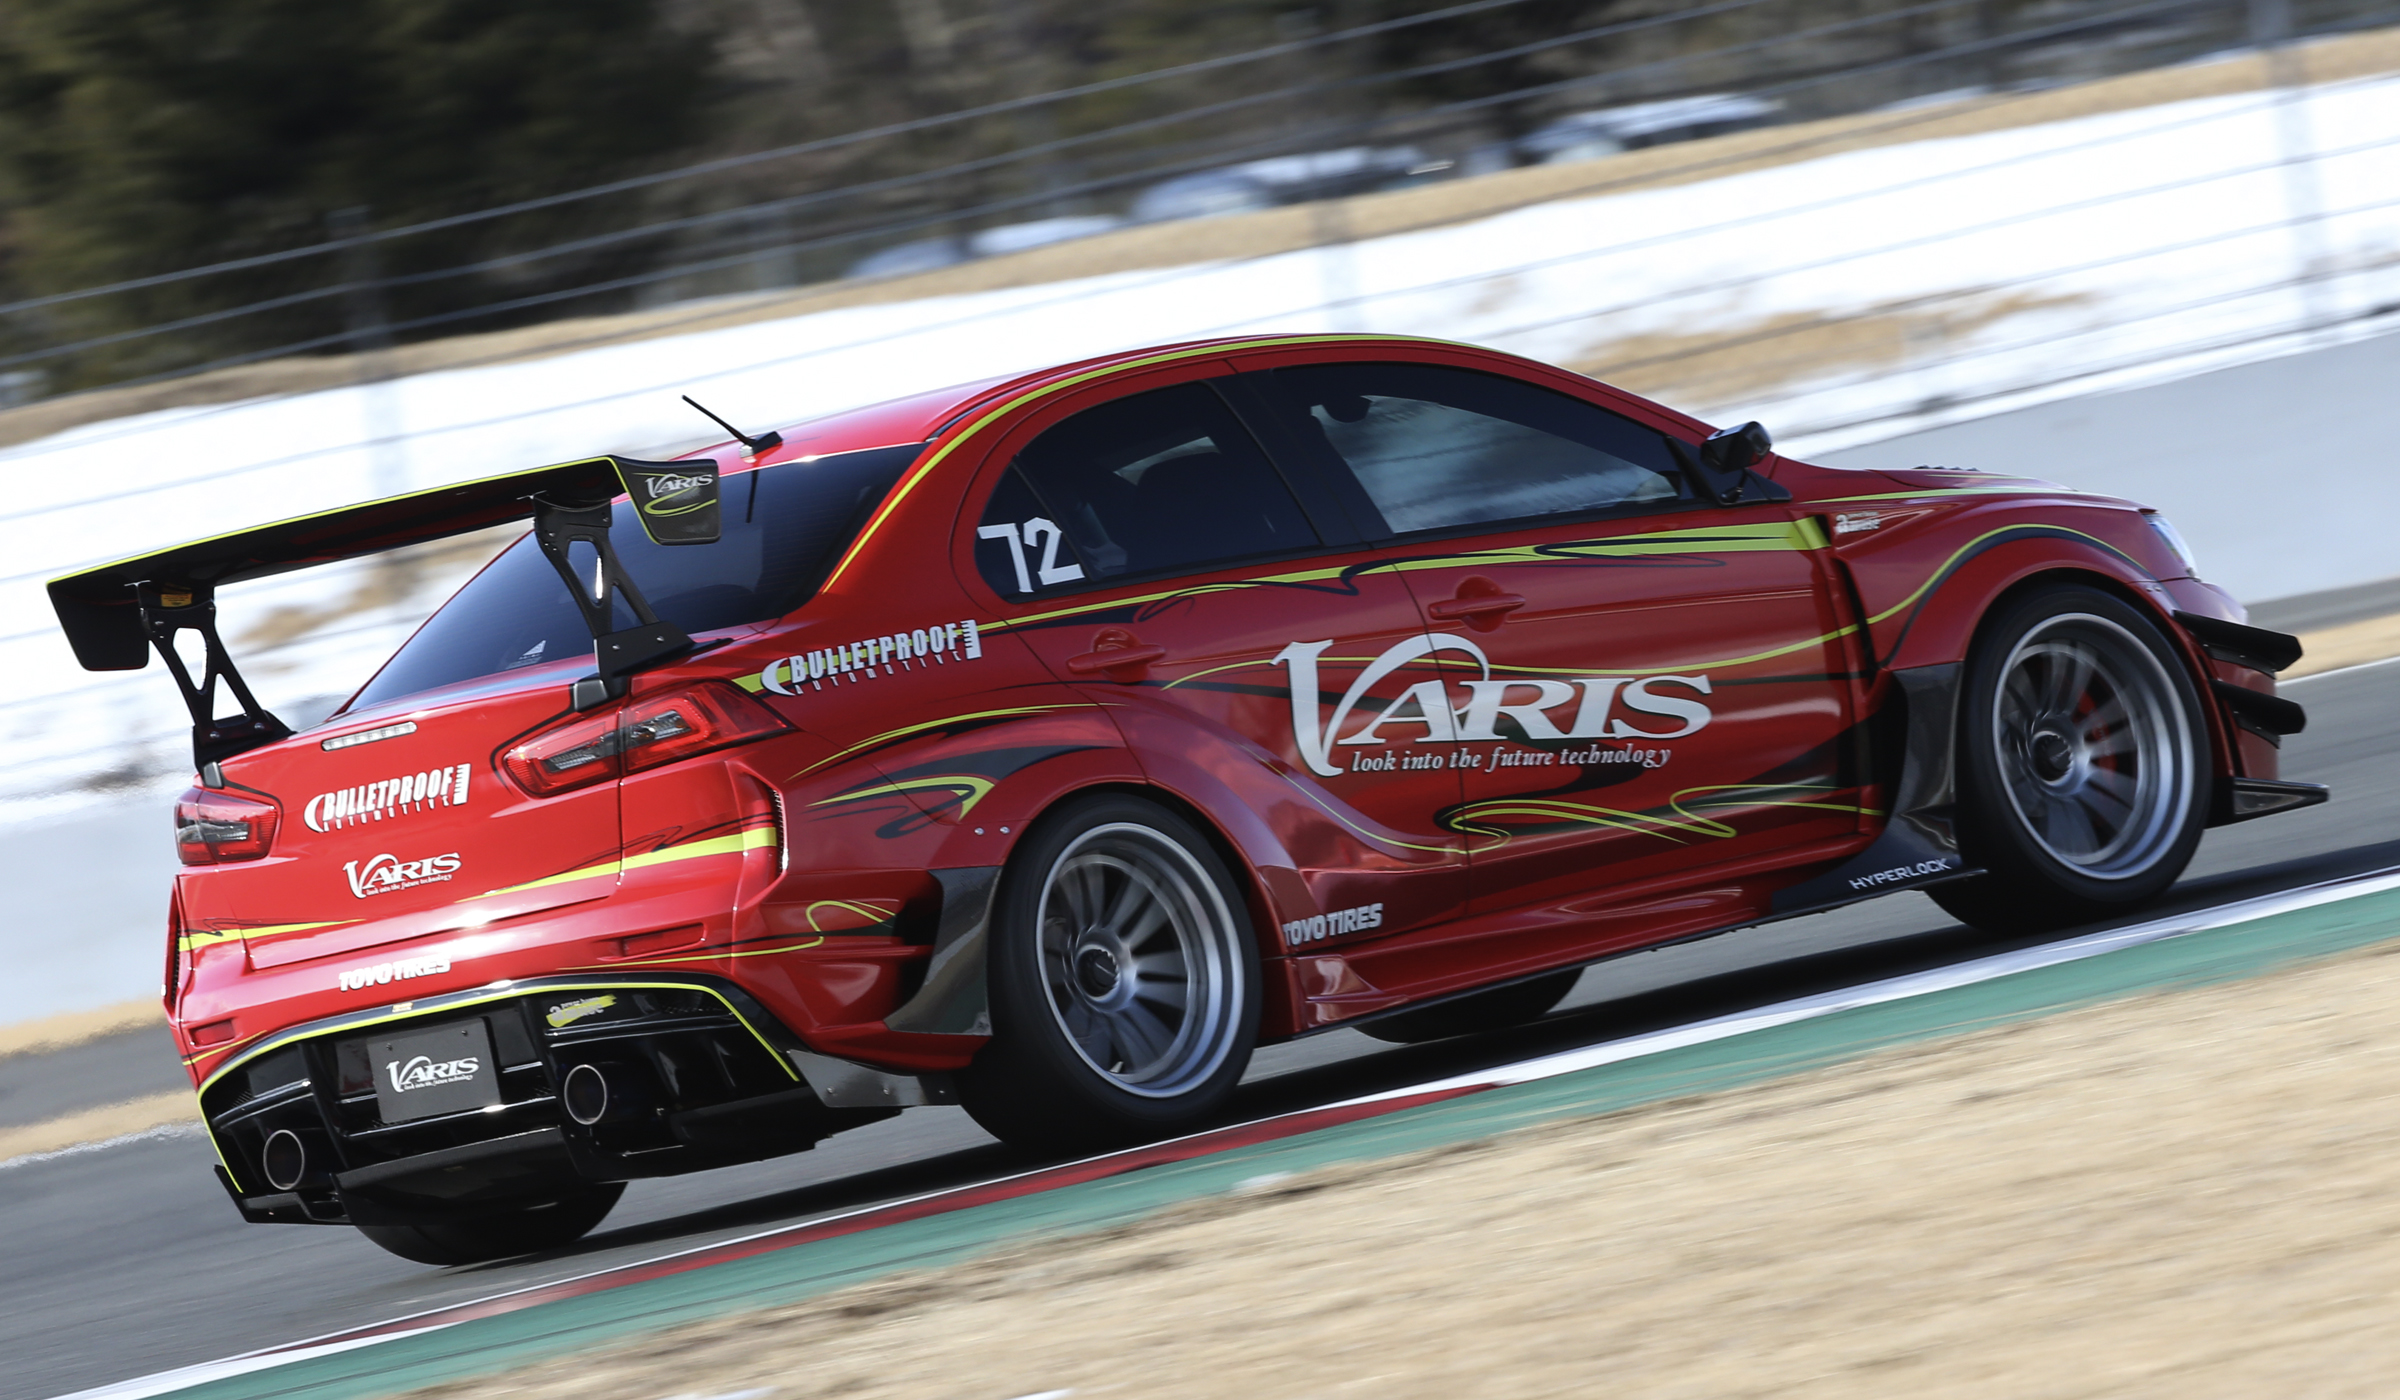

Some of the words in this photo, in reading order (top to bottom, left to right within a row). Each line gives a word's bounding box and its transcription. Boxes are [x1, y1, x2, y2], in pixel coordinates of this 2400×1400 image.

[645, 473, 713, 498] VARIS
[977, 517, 1085, 593] 72
[788, 622, 958, 684] BULLETPROOF
[1269, 633, 1713, 777] VARIS
[1352, 750, 1397, 772] look
[1402, 750, 1444, 770] into
[1449, 747, 1482, 768] the
[1484, 746, 1554, 773] future
[1559, 743, 1672, 768] technology
[322, 766, 455, 822] BULLETPROOF
[343, 853, 462, 899] VARIS
[1848, 858, 1952, 889] HYPERLOCK
[385, 1055, 479, 1093] VARIS
